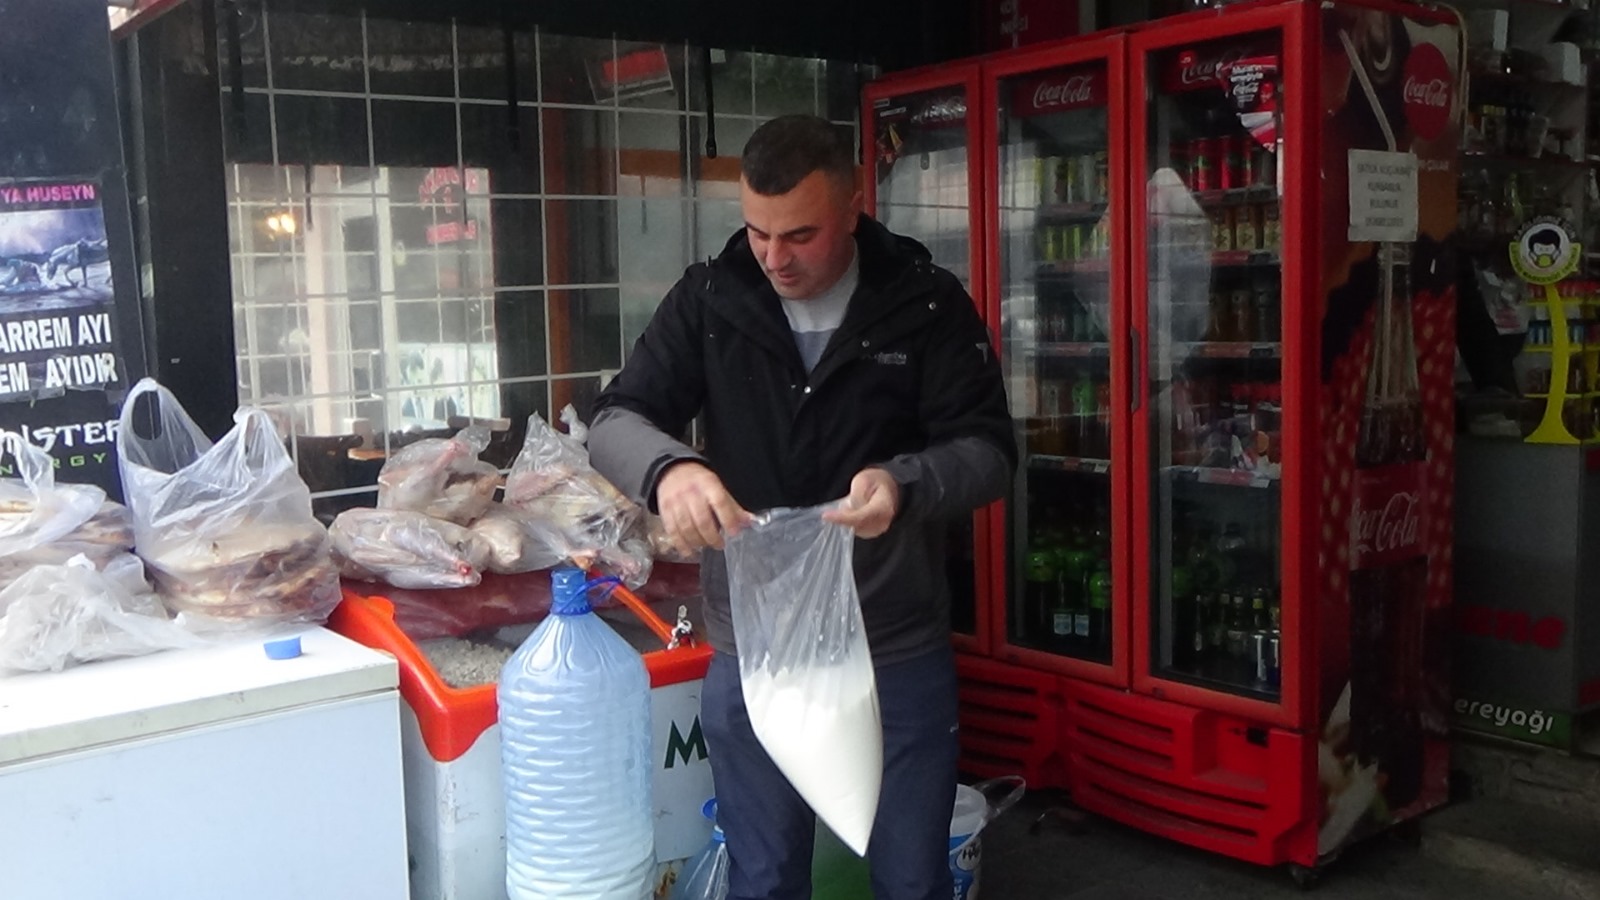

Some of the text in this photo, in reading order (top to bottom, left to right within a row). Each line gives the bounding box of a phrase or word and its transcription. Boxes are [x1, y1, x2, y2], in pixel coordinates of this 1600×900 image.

[1033, 75, 1093, 108] Coca-Cola
[1403, 75, 1448, 108] Coca-Cola
[1, 185, 95, 204] YA HUSEYN
[78, 313, 111, 345] AYI
[46, 352, 118, 388] AYIDIR
